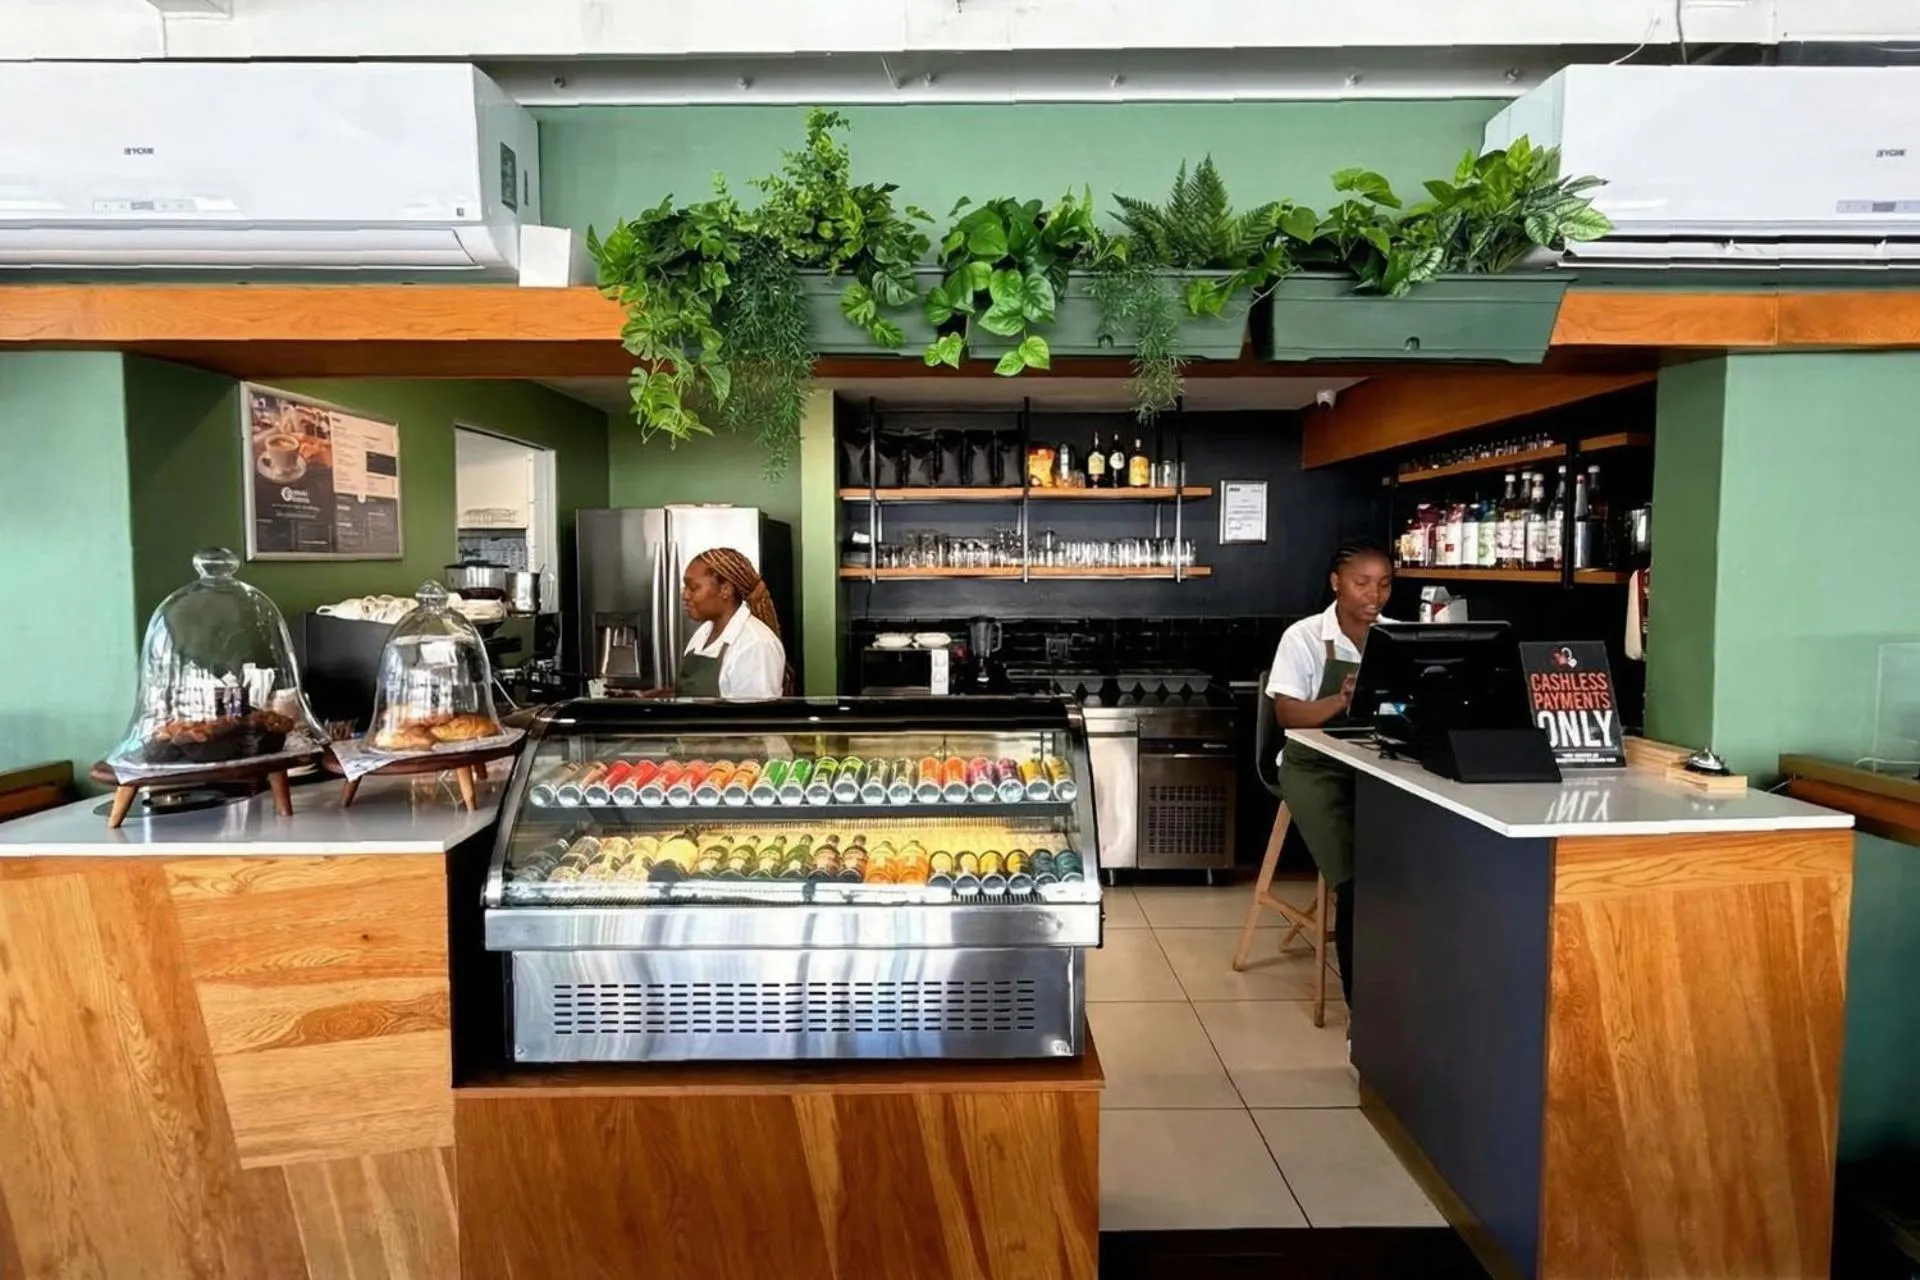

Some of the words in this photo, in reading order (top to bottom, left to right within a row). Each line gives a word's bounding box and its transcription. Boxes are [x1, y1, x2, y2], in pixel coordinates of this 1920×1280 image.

[1530, 672, 1608, 691] CASHLESS
[1534, 692, 1611, 710] PAYMENTS
[1537, 710, 1614, 748] ONLY
